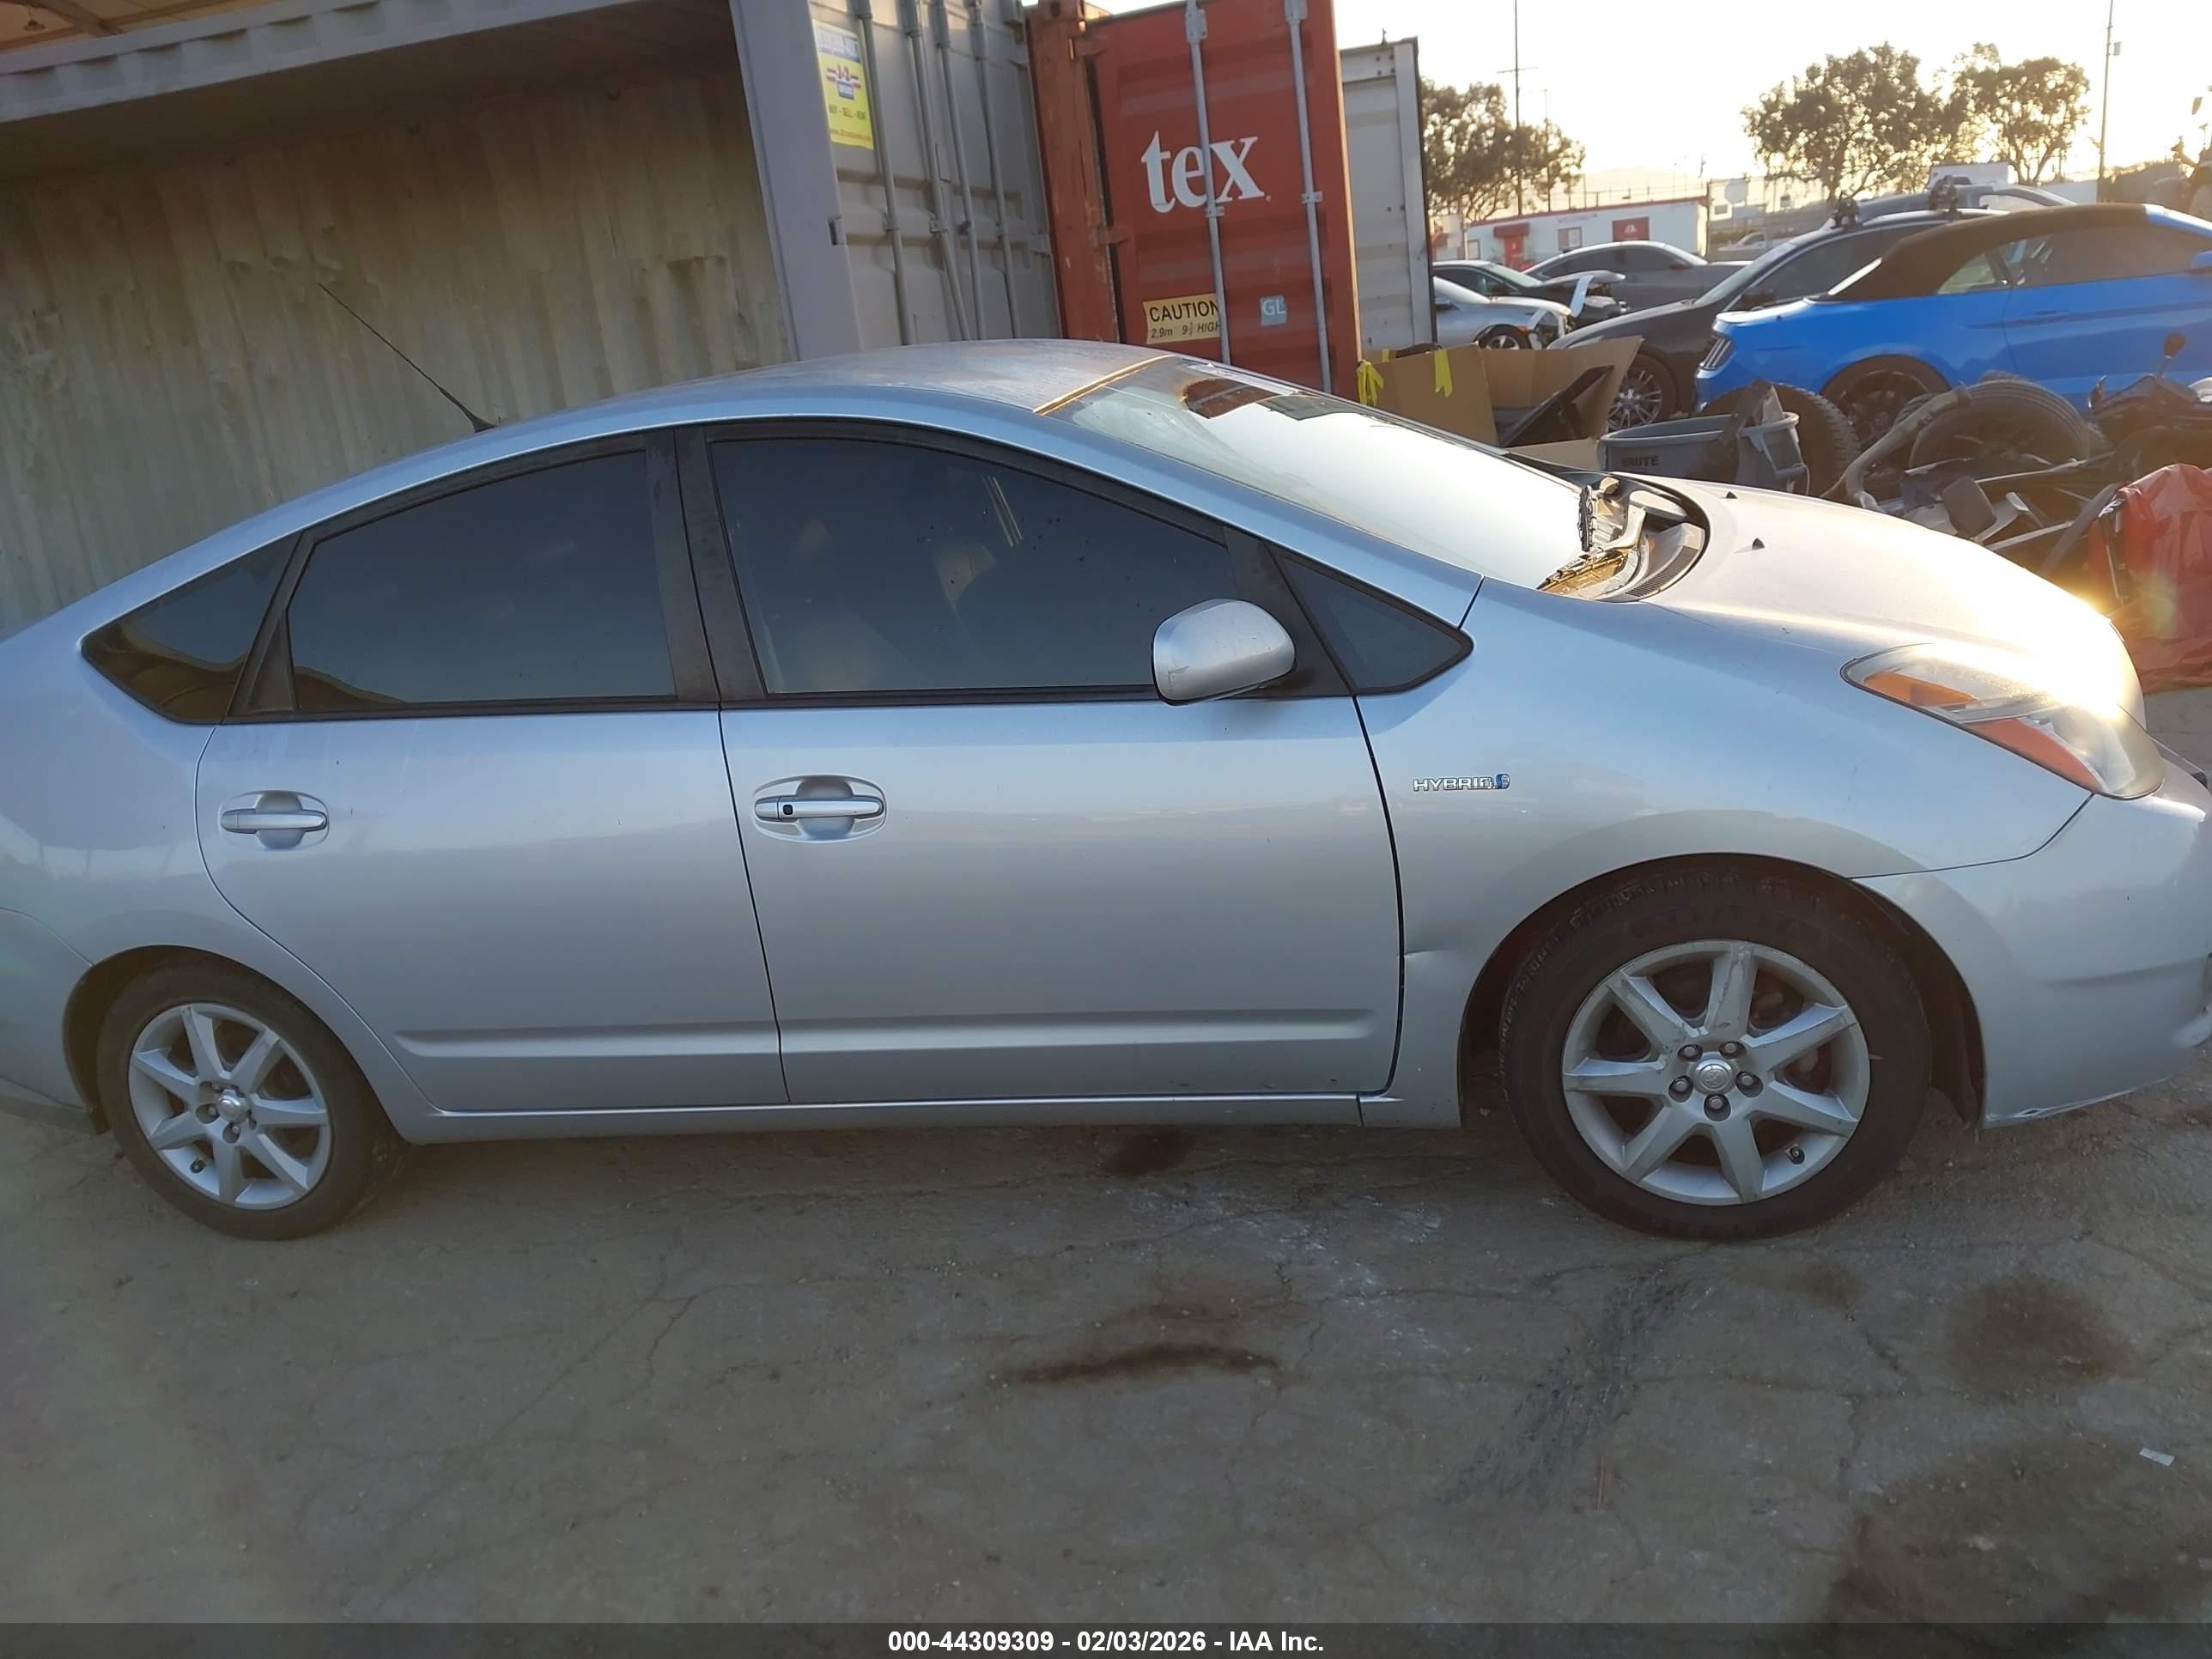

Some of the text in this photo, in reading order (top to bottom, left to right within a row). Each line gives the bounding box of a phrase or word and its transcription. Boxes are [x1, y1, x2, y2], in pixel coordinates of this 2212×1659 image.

[1149, 301, 1219, 323] CAUTION
[1262, 299, 1285, 316] GL
[1151, 327, 1174, 339] 2.9m
[1413, 777, 1494, 791] HYBRID
